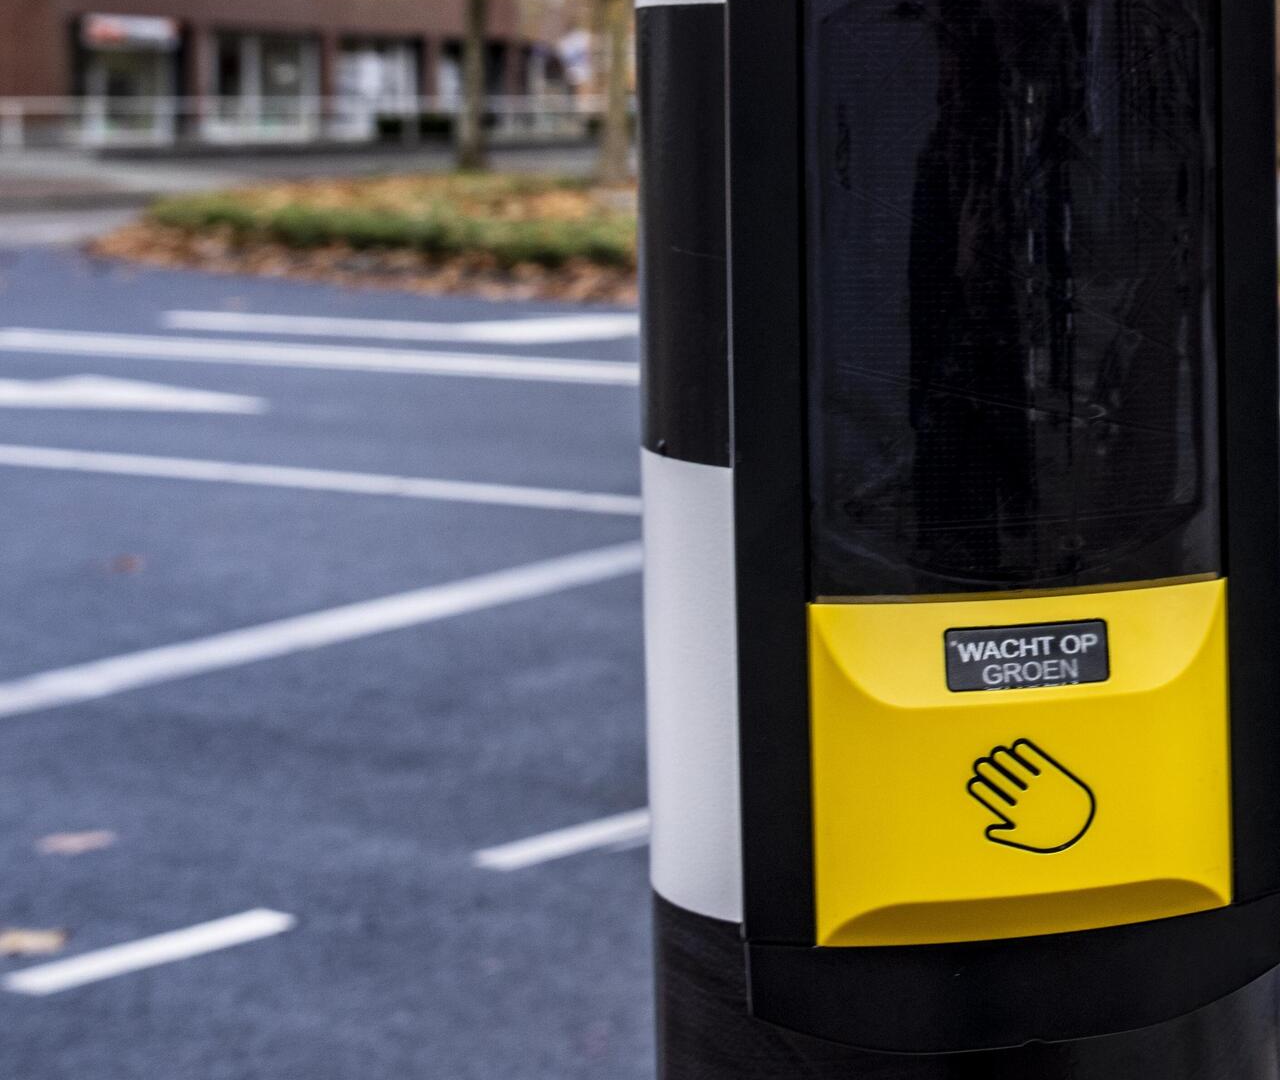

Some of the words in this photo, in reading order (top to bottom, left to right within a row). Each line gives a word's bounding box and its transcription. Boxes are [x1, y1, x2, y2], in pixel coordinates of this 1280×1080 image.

[957, 635, 1055, 663] WACHT
[1059, 633, 1098, 655] OP
[981, 658, 1080, 685] GROEN
